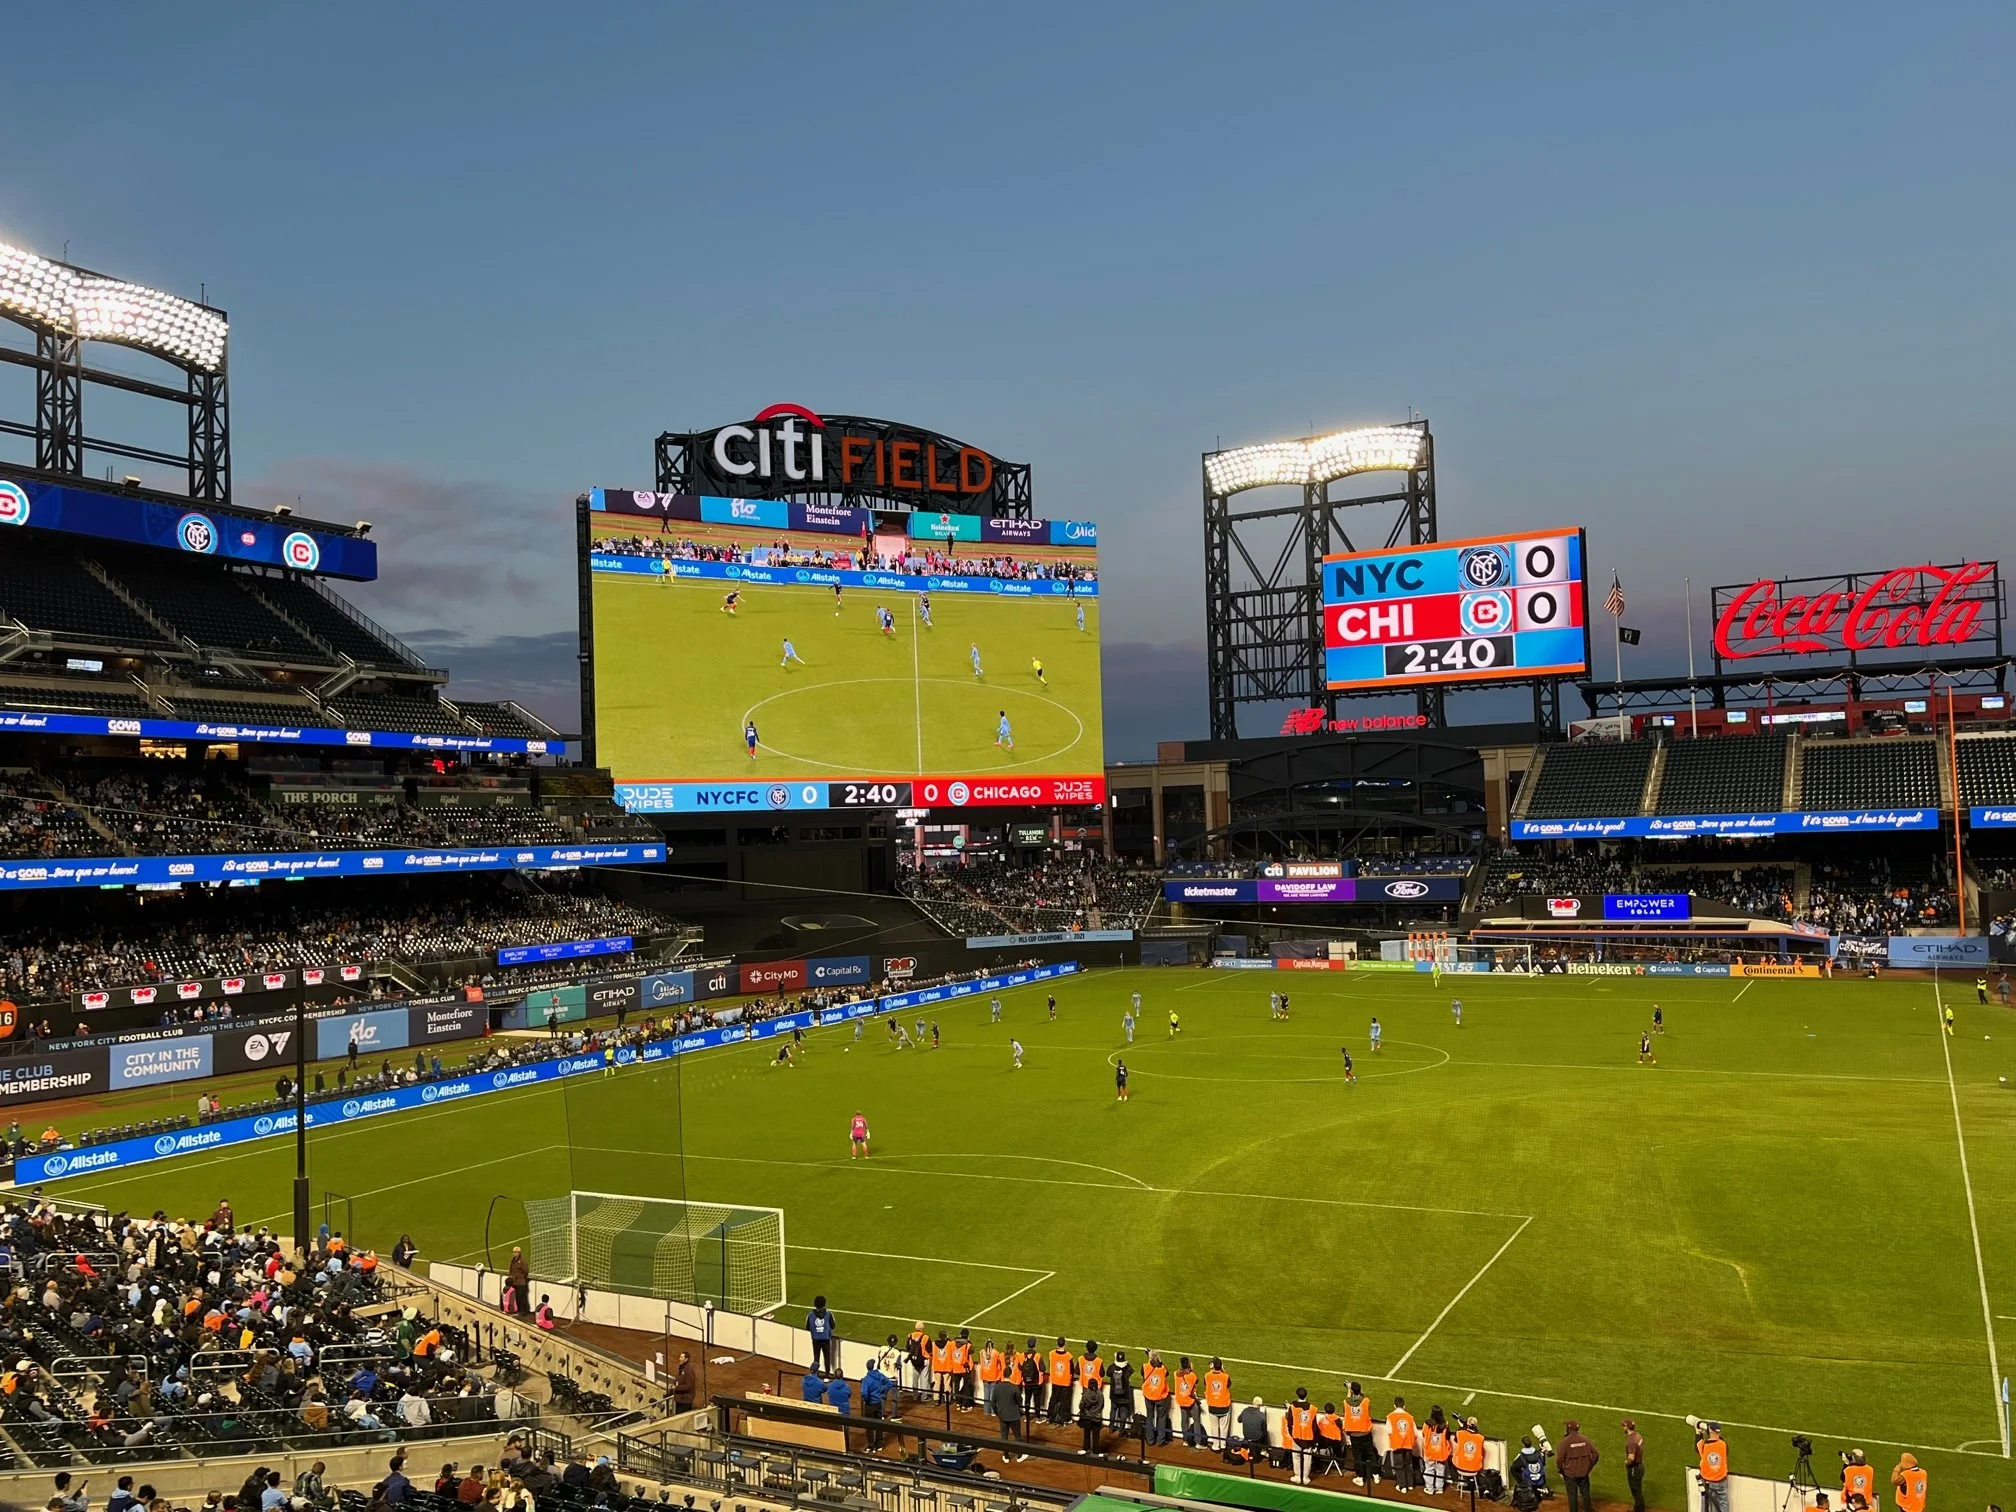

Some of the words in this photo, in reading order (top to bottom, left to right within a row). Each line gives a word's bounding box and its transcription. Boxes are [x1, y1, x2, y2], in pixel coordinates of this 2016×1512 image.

[713, 416, 825, 482] citi
[840, 435, 994, 494] FIELD
[731, 498, 757, 518] flo
[805, 503, 852, 518] Montefiore
[806, 513, 841, 526] Einstein
[989, 518, 1042, 530] ETIHAD
[1001, 529, 1031, 537] AIRWAYS
[1335, 559, 1425, 598] NYC
[1525, 544, 1556, 578] 0
[1337, 602, 1414, 642] CHI
[1527, 591, 1557, 625] 0
[1714, 560, 1997, 660] Coca-Cola
[1403, 638, 1495, 674] 2:40
[1328, 713, 1359, 730] new
[1362, 713, 1428, 730] balance
[282, 791, 309, 804] THE
[312, 792, 358, 804] PORCH
[622, 787, 675, 800] DUDE
[696, 790, 760, 806] NYCFC
[802, 785, 818, 804] 0
[843, 784, 898, 804] 2:40
[923, 784, 939, 803] 0
[973, 786, 1042, 800] CHICAGO
[1053, 781, 1094, 793] DUDE
[1053, 792, 1094, 801] WIPES
[1289, 866, 1339, 876] PAVILION
[1183, 886, 1238, 897] ticketmaster
[1274, 883, 1316, 891] DAVIDOFF
[1316, 883, 1337, 891] LAW
[1392, 883, 1421, 896] Ford
[1616, 899, 1675, 908] EMPOWER
[1912, 944, 1979, 953] ETIHAD
[826, 966, 852, 978] Capital
[852, 965, 862, 974] Rx
[1567, 963, 1632, 975] Heineken
[1743, 965, 1796, 976] Continental
[708, 975, 727, 991] citi
[408, 996, 440, 1007] FOOTBALL
[440, 995, 456, 1003] CLUB
[592, 986, 636, 1001] ETIHAD
[426, 1008, 474, 1023] Montefiore
[199, 1024, 218, 1033] JOIN
[219, 1021, 234, 1030] THE
[427, 1020, 462, 1034] Einstein
[48, 1041, 69, 1051] NEW
[72, 1038, 95, 1048] YORK
[97, 1036, 116, 1046] CITY
[118, 1030, 161, 1043] FOOTBALL
[162, 1028, 184, 1038] CLUB
[249, 1040, 265, 1050] EA
[125, 1052, 156, 1066] CITY
[159, 1050, 173, 1061] IN
[175, 1047, 200, 1059] THE
[571, 1057, 599, 1071] Allstate
[15, 1065, 53, 1079] CLUB
[123, 1058, 201, 1078] COMMUNITY
[507, 1069, 538, 1084] Allstate
[437, 1082, 471, 1098] Allstate
[360, 1096, 397, 1113] Allstate
[273, 1112, 314, 1130] Allstte
[176, 1130, 222, 1150] Allstate
[67, 1150, 120, 1171] Allstate
